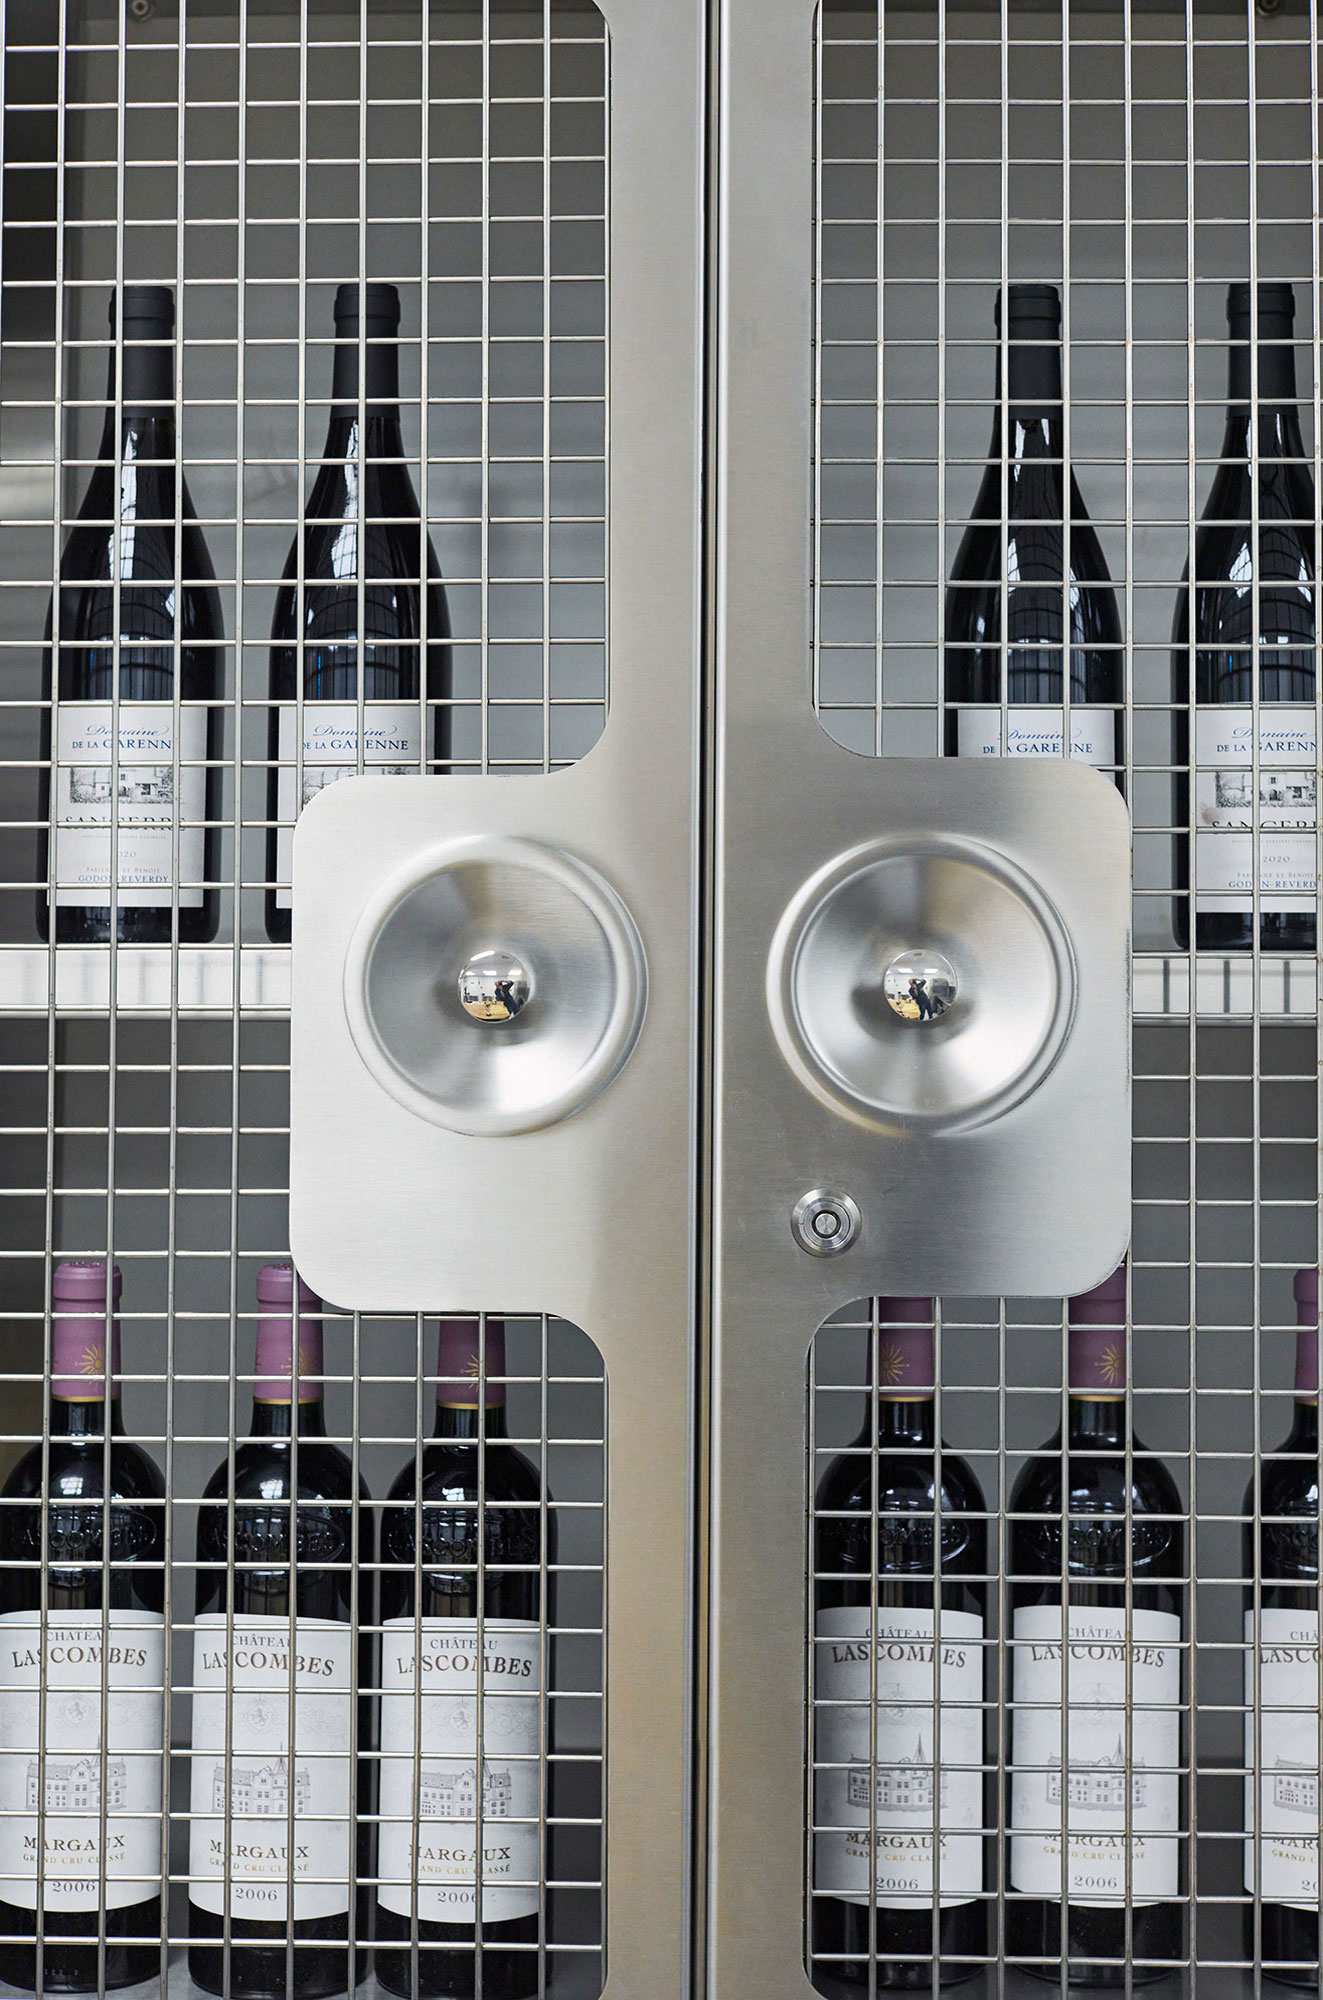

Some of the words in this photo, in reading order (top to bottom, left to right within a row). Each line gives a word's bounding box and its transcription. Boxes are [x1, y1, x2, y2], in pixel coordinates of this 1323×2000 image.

[313, 724, 398, 737] Domine
[72, 741, 84, 749] DE
[87, 741, 99, 749] LA
[103, 738, 173, 750] GARENN
[315, 742, 327, 750] LA
[1016, 742, 1093, 754] GARENE
[1216, 744, 1230, 753] DE
[1234, 744, 1247, 752] LA
[1068, 1626, 1125, 1640] CHÂTEA
[232, 1634, 290, 1648] CHÂTEA
[832, 1644, 967, 1668] LASCOMES
[210, 1839, 310, 1859] MRGAUX
[23, 1853, 58, 1864] GRND
[88, 1852, 126, 1864] CLSSÉ
[209, 1857, 240, 1870] GRAD
[52, 1881, 97, 1893] 2006
[875, 1876, 919, 1890] 2006
[1073, 1875, 1118, 1889] 2006
[235, 1887, 278, 1901] 2006
